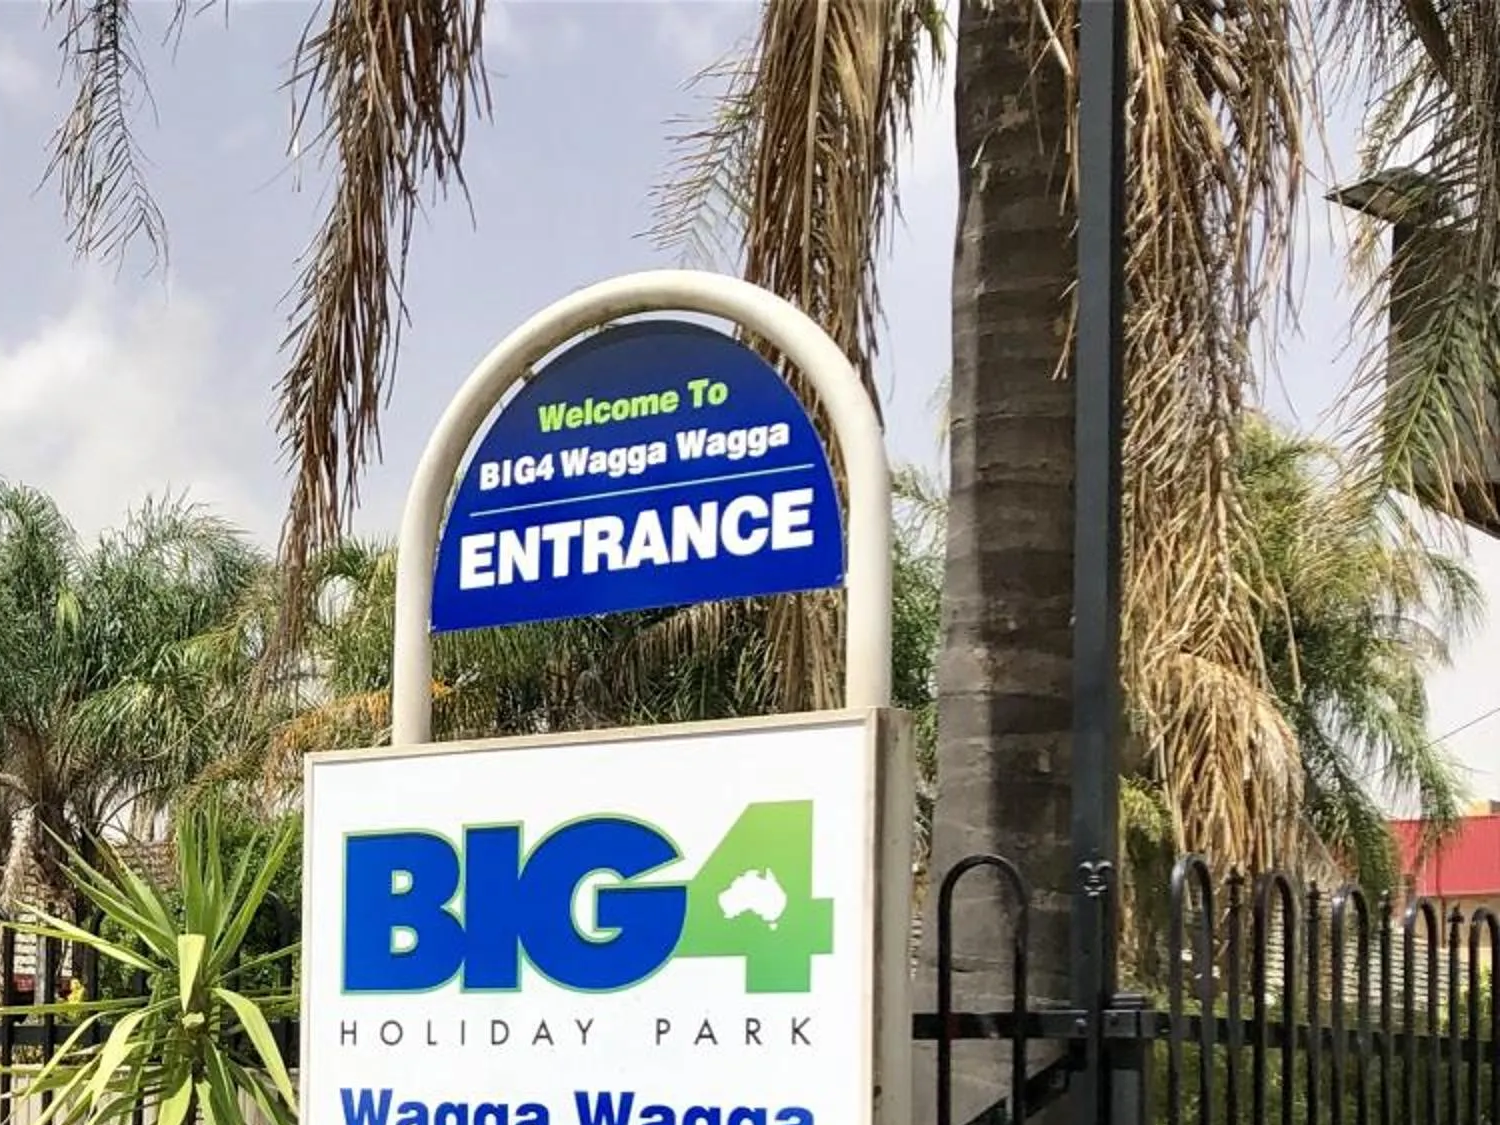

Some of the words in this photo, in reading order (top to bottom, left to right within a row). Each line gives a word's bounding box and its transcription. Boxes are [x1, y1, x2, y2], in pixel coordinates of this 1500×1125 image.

[538, 389, 679, 433] Welcome
[687, 377, 729, 409] To
[479, 451, 554, 491] BIG4
[560, 438, 667, 479] Wagga
[676, 421, 790, 463] Wagga
[458, 487, 815, 592] ENTRANCE
[340, 799, 835, 997] BIG4
[341, 1019, 595, 1047] HOLIDAY
[655, 1017, 812, 1046] PARK
